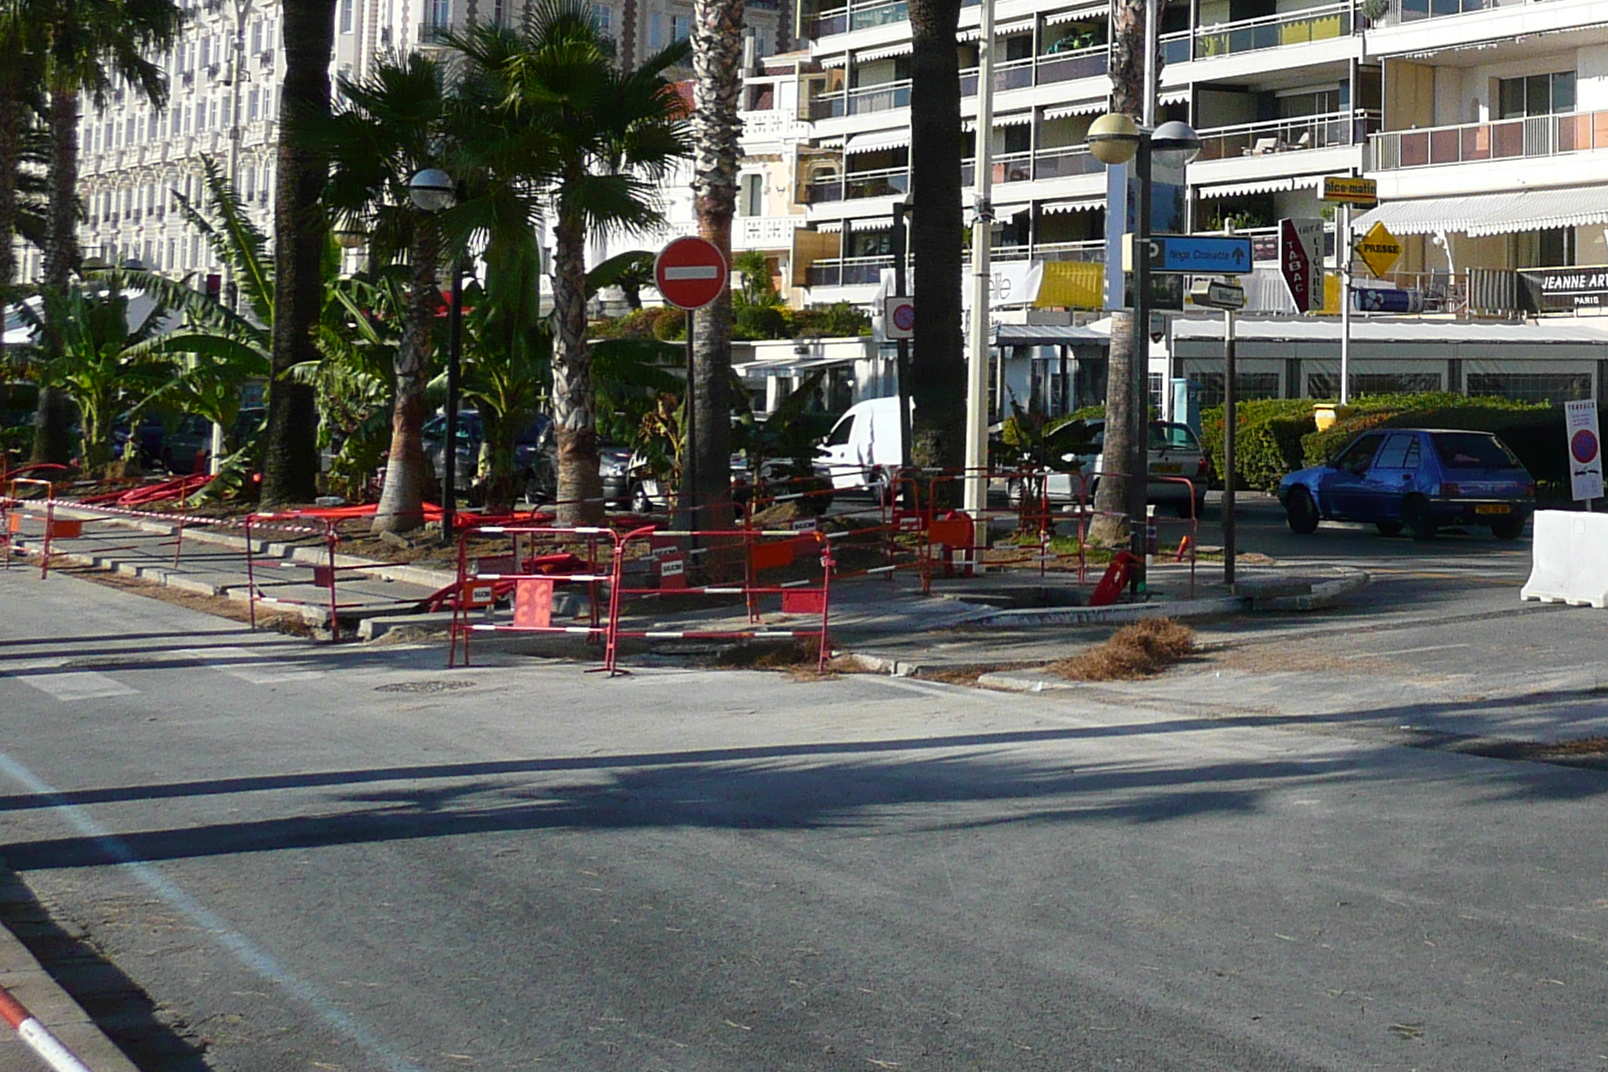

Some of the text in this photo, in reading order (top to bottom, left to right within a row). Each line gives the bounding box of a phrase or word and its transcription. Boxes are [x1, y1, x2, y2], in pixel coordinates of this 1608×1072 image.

[1324, 181, 1376, 193] nice-matin
[1364, 243, 1400, 254] PRESSE
[1286, 241, 1303, 292] TABAC
[1541, 274, 1586, 290] JEANNE
[1574, 296, 1599, 305] PARIS
